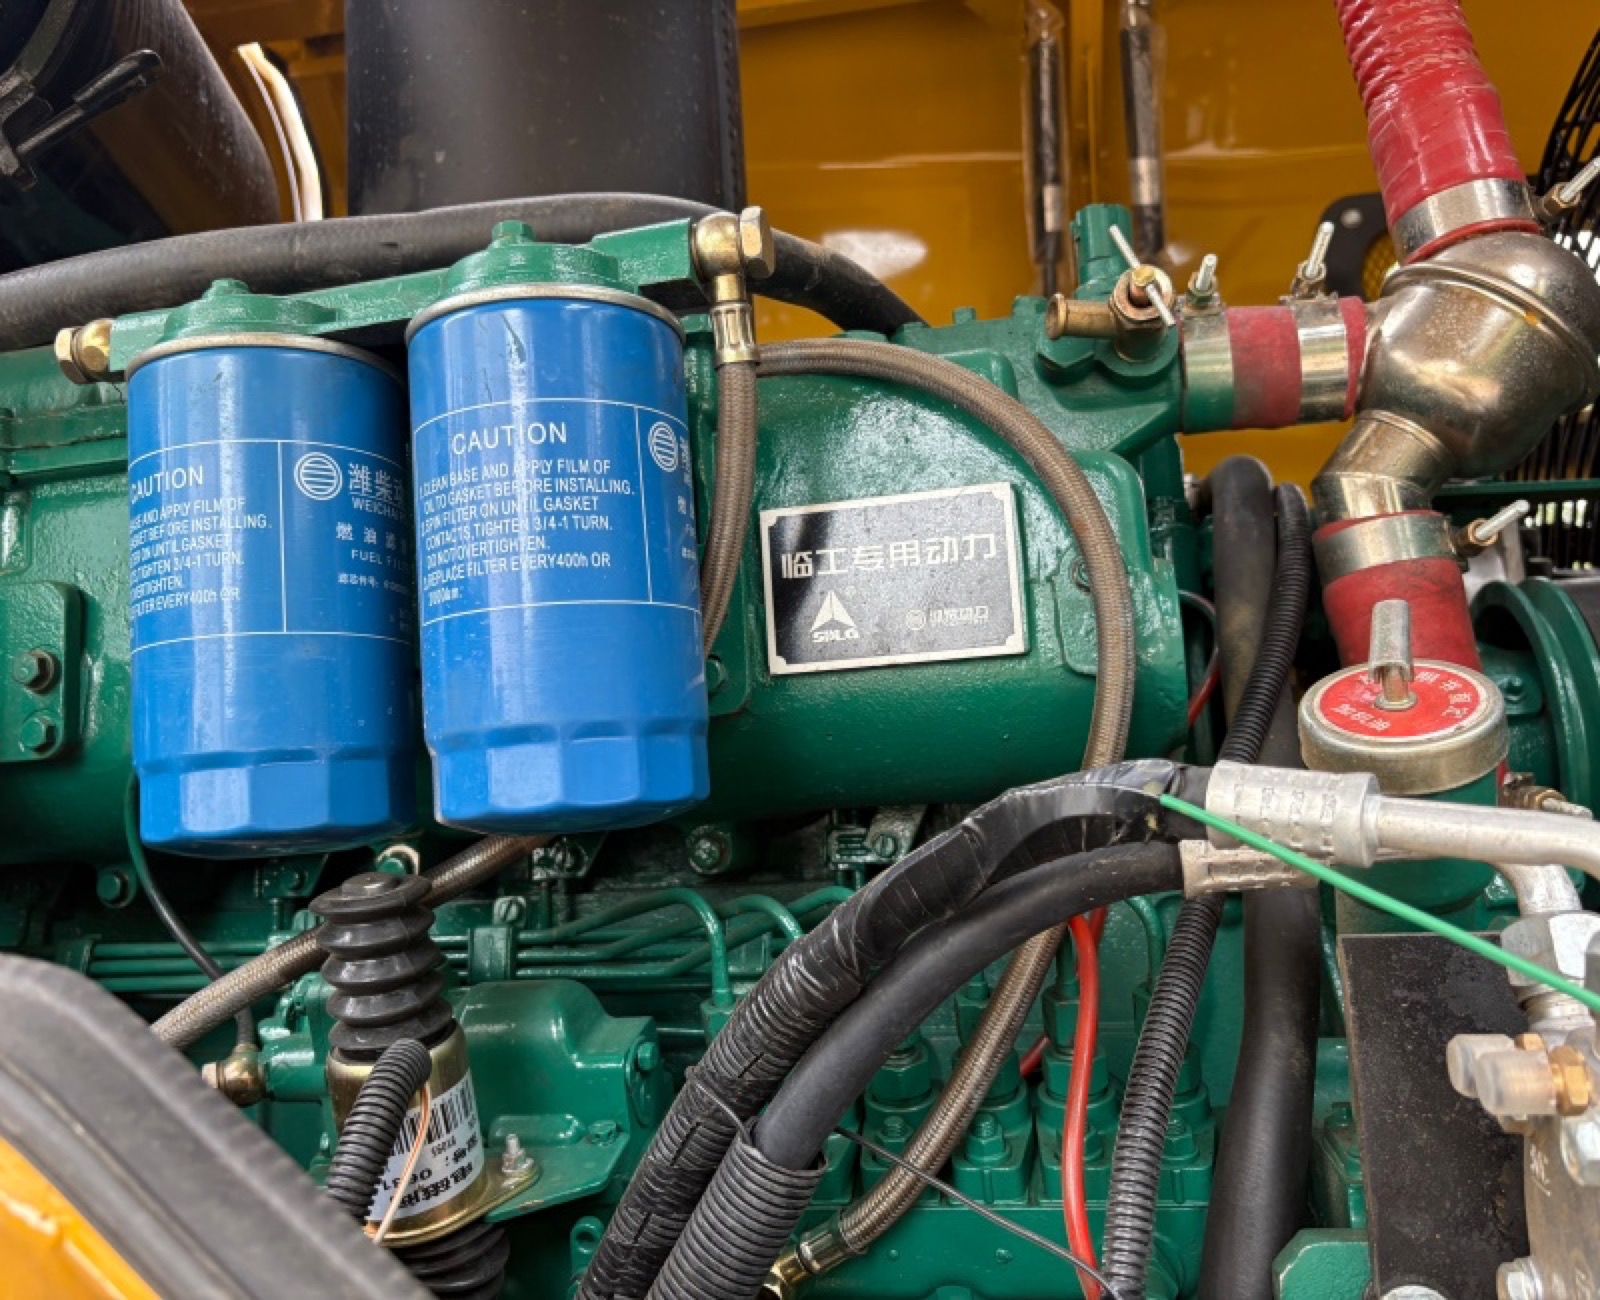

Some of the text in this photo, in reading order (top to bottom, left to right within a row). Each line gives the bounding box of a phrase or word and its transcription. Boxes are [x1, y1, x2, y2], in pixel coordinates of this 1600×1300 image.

[452, 421, 567, 455] CAUTION
[449, 466, 478, 487] BASE
[482, 462, 509, 480] AND
[512, 459, 553, 477] APPLY
[557, 457, 590, 474] FILM
[593, 459, 611, 475] OF
[447, 483, 492, 506] GASKET
[495, 477, 553, 497] BEFORE
[555, 477, 635, 495] INSTALLING.
[160, 502, 192, 520] APPLY
[193, 497, 225, 514] FILM
[227, 497, 246, 511] OF
[443, 505, 477, 527] FILTER
[480, 500, 499, 519] ON
[543, 495, 599, 513] GASKET
[571, 514, 613, 531] TURN.
[181, 533, 232, 553] GASKET
[781, 533, 997, 579] 临工专用动力
[352, 549, 383, 565] FUEL
[467, 557, 508, 577] FILTER
[591, 552, 611, 568] OR
